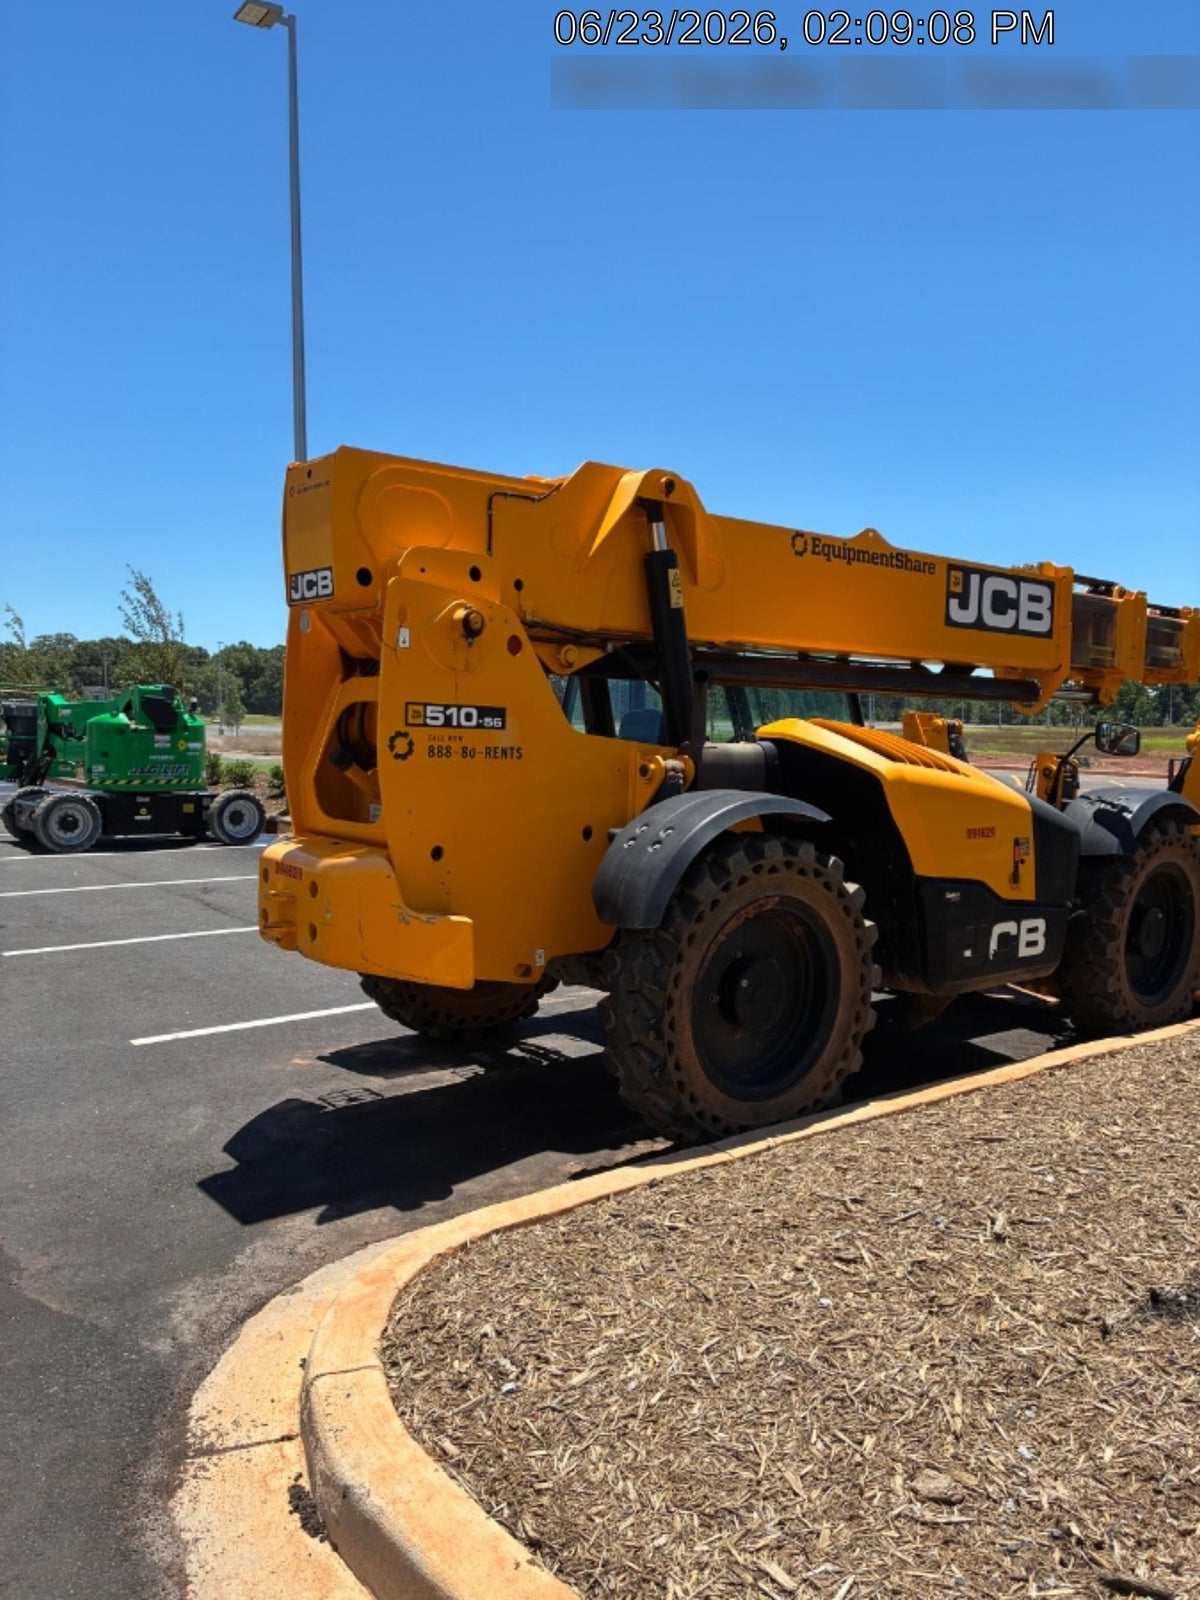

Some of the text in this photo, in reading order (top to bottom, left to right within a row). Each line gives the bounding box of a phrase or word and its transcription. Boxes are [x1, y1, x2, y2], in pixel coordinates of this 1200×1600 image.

[811, 537, 936, 574] EquipmentShare
[291, 570, 333, 599] JCB
[949, 573, 1051, 633] JCB
